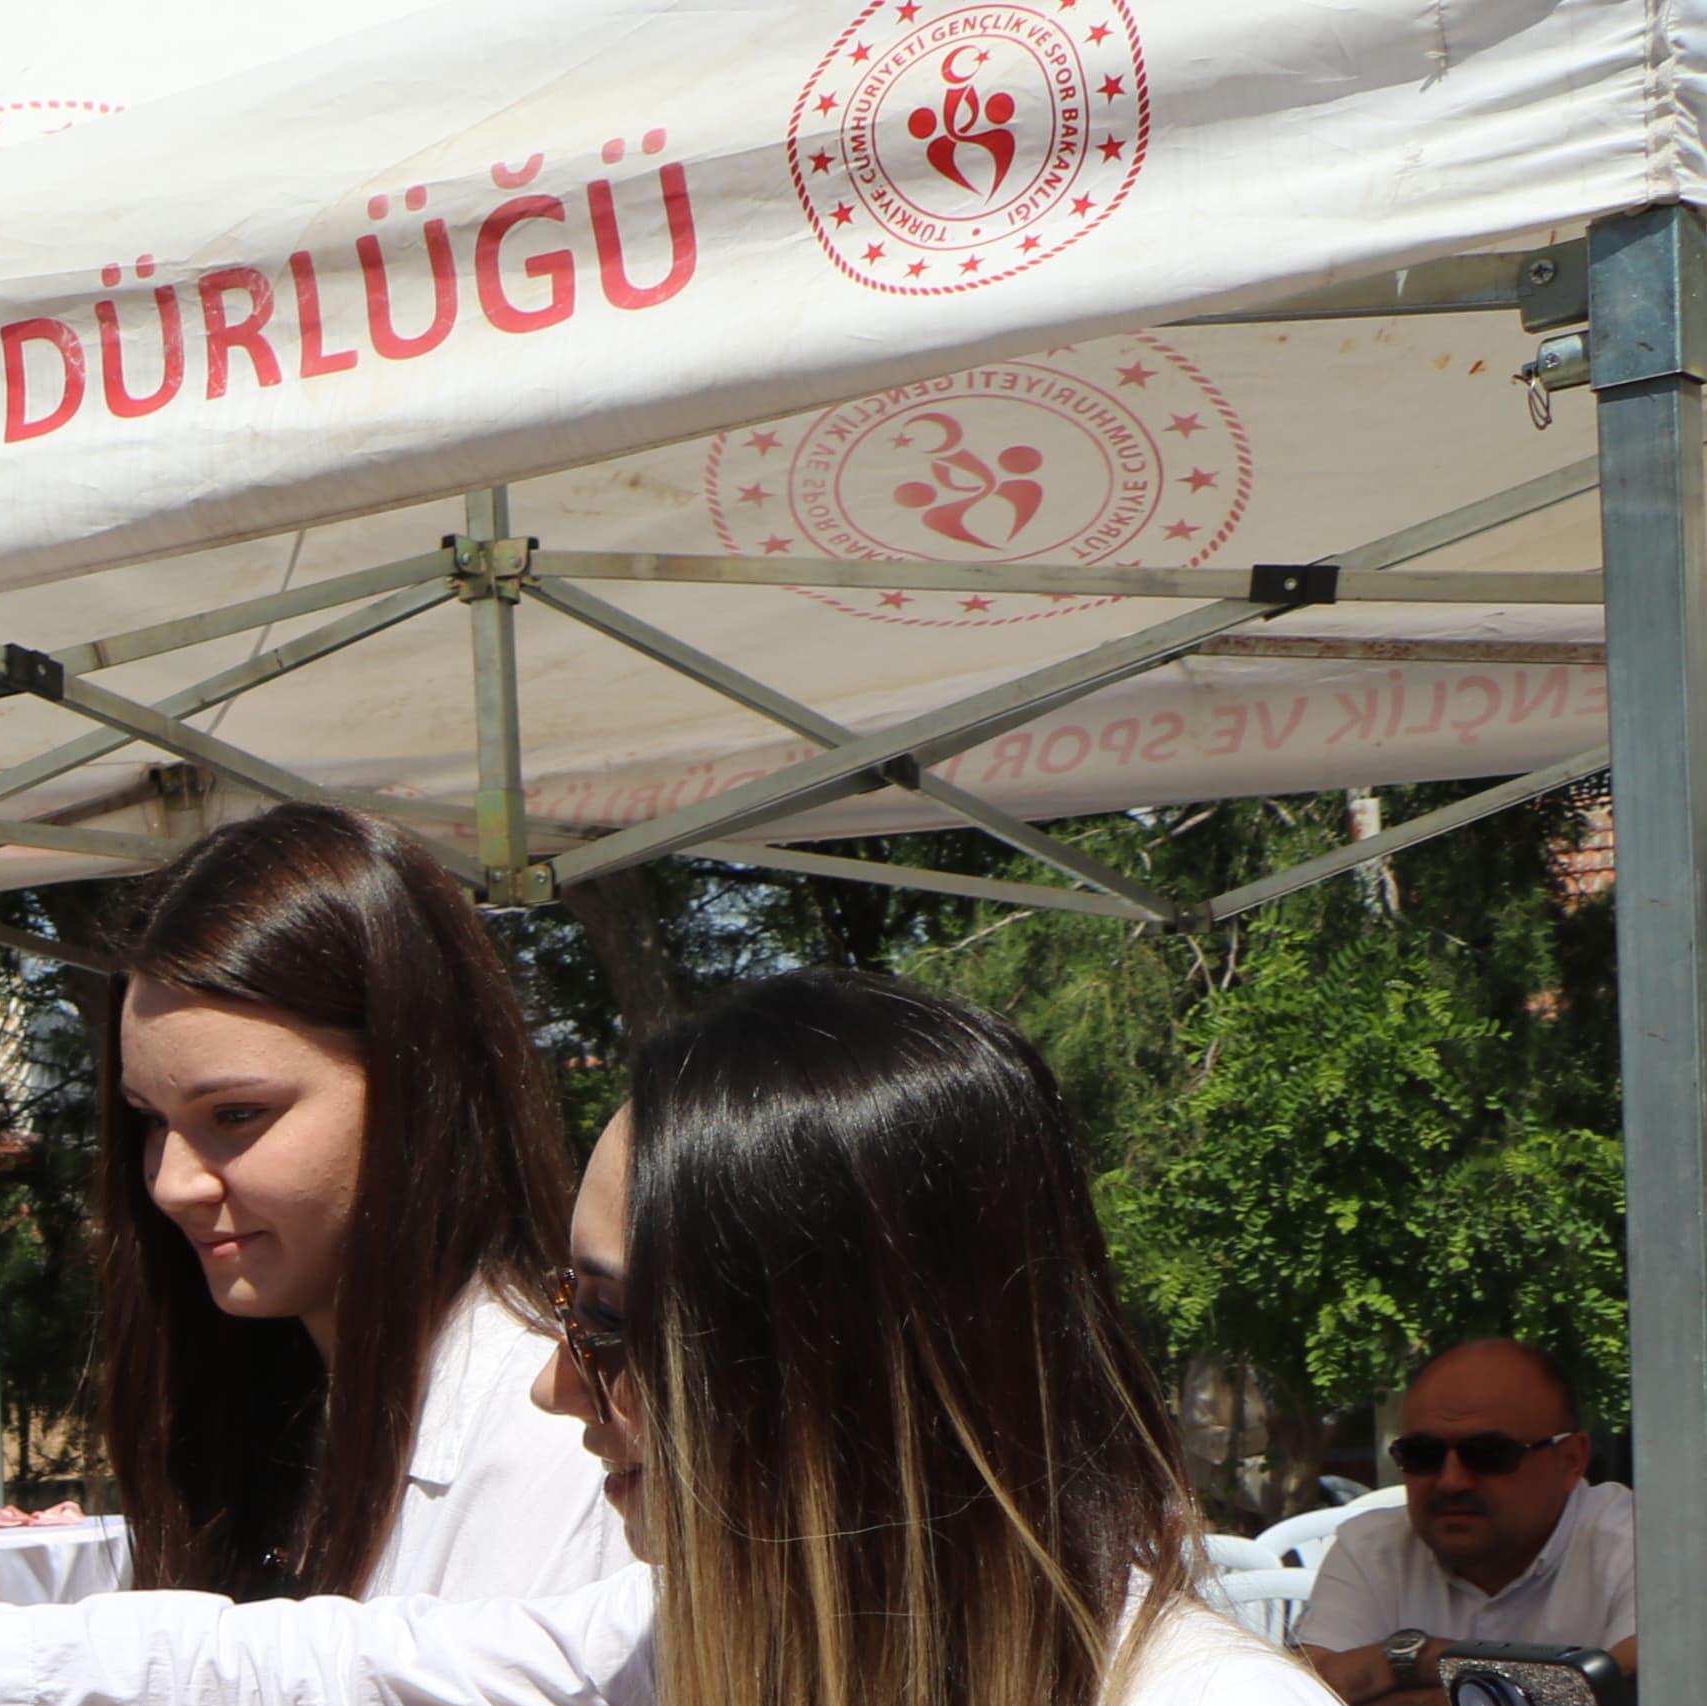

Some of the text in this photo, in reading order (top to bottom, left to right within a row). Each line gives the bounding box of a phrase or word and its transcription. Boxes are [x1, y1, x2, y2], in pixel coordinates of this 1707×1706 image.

[850, 12, 1079, 243] TÜRKİYE CUMHURİYETİ GENÇLİK VE SPOR BAKANLIĞI
